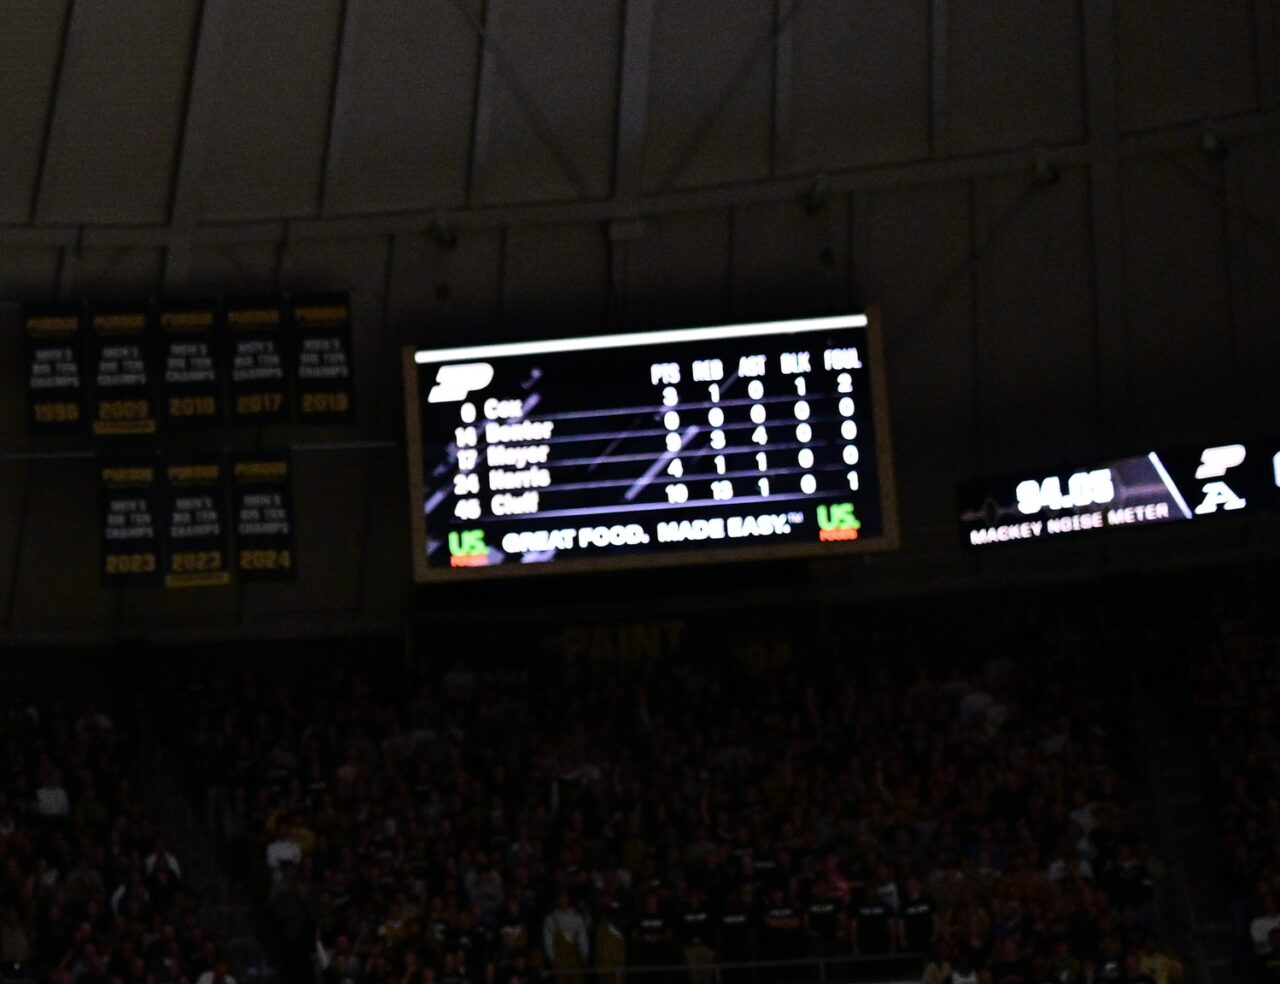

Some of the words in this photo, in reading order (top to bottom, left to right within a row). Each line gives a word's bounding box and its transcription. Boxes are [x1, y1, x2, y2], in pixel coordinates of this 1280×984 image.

[709, 384, 719, 402] 1
[748, 380, 763, 399] 0
[795, 377, 806, 396] 1
[837, 373, 852, 392] 2
[664, 411, 679, 430] 0
[708, 407, 723, 427] 0
[751, 404, 766, 424] 0
[794, 401, 809, 420] 0
[839, 397, 854, 417] 0
[752, 426, 767, 445] 4
[796, 423, 811, 442] 0
[841, 420, 856, 440] 0
[668, 458, 683, 477] 4
[714, 455, 725, 474] 1
[756, 452, 766, 471] 1
[798, 449, 813, 468] 0
[843, 445, 858, 464] 0
[758, 478, 769, 497] 1
[800, 474, 816, 494] 0
[847, 471, 858, 490] 1
[1194, 481, 1246, 514] A
[502, 529, 576, 553] GREAT
[657, 519, 725, 542] MADE
[970, 521, 1042, 544] MACKEY
[1047, 512, 1102, 533] NOISE
[1108, 502, 1169, 525] METER
